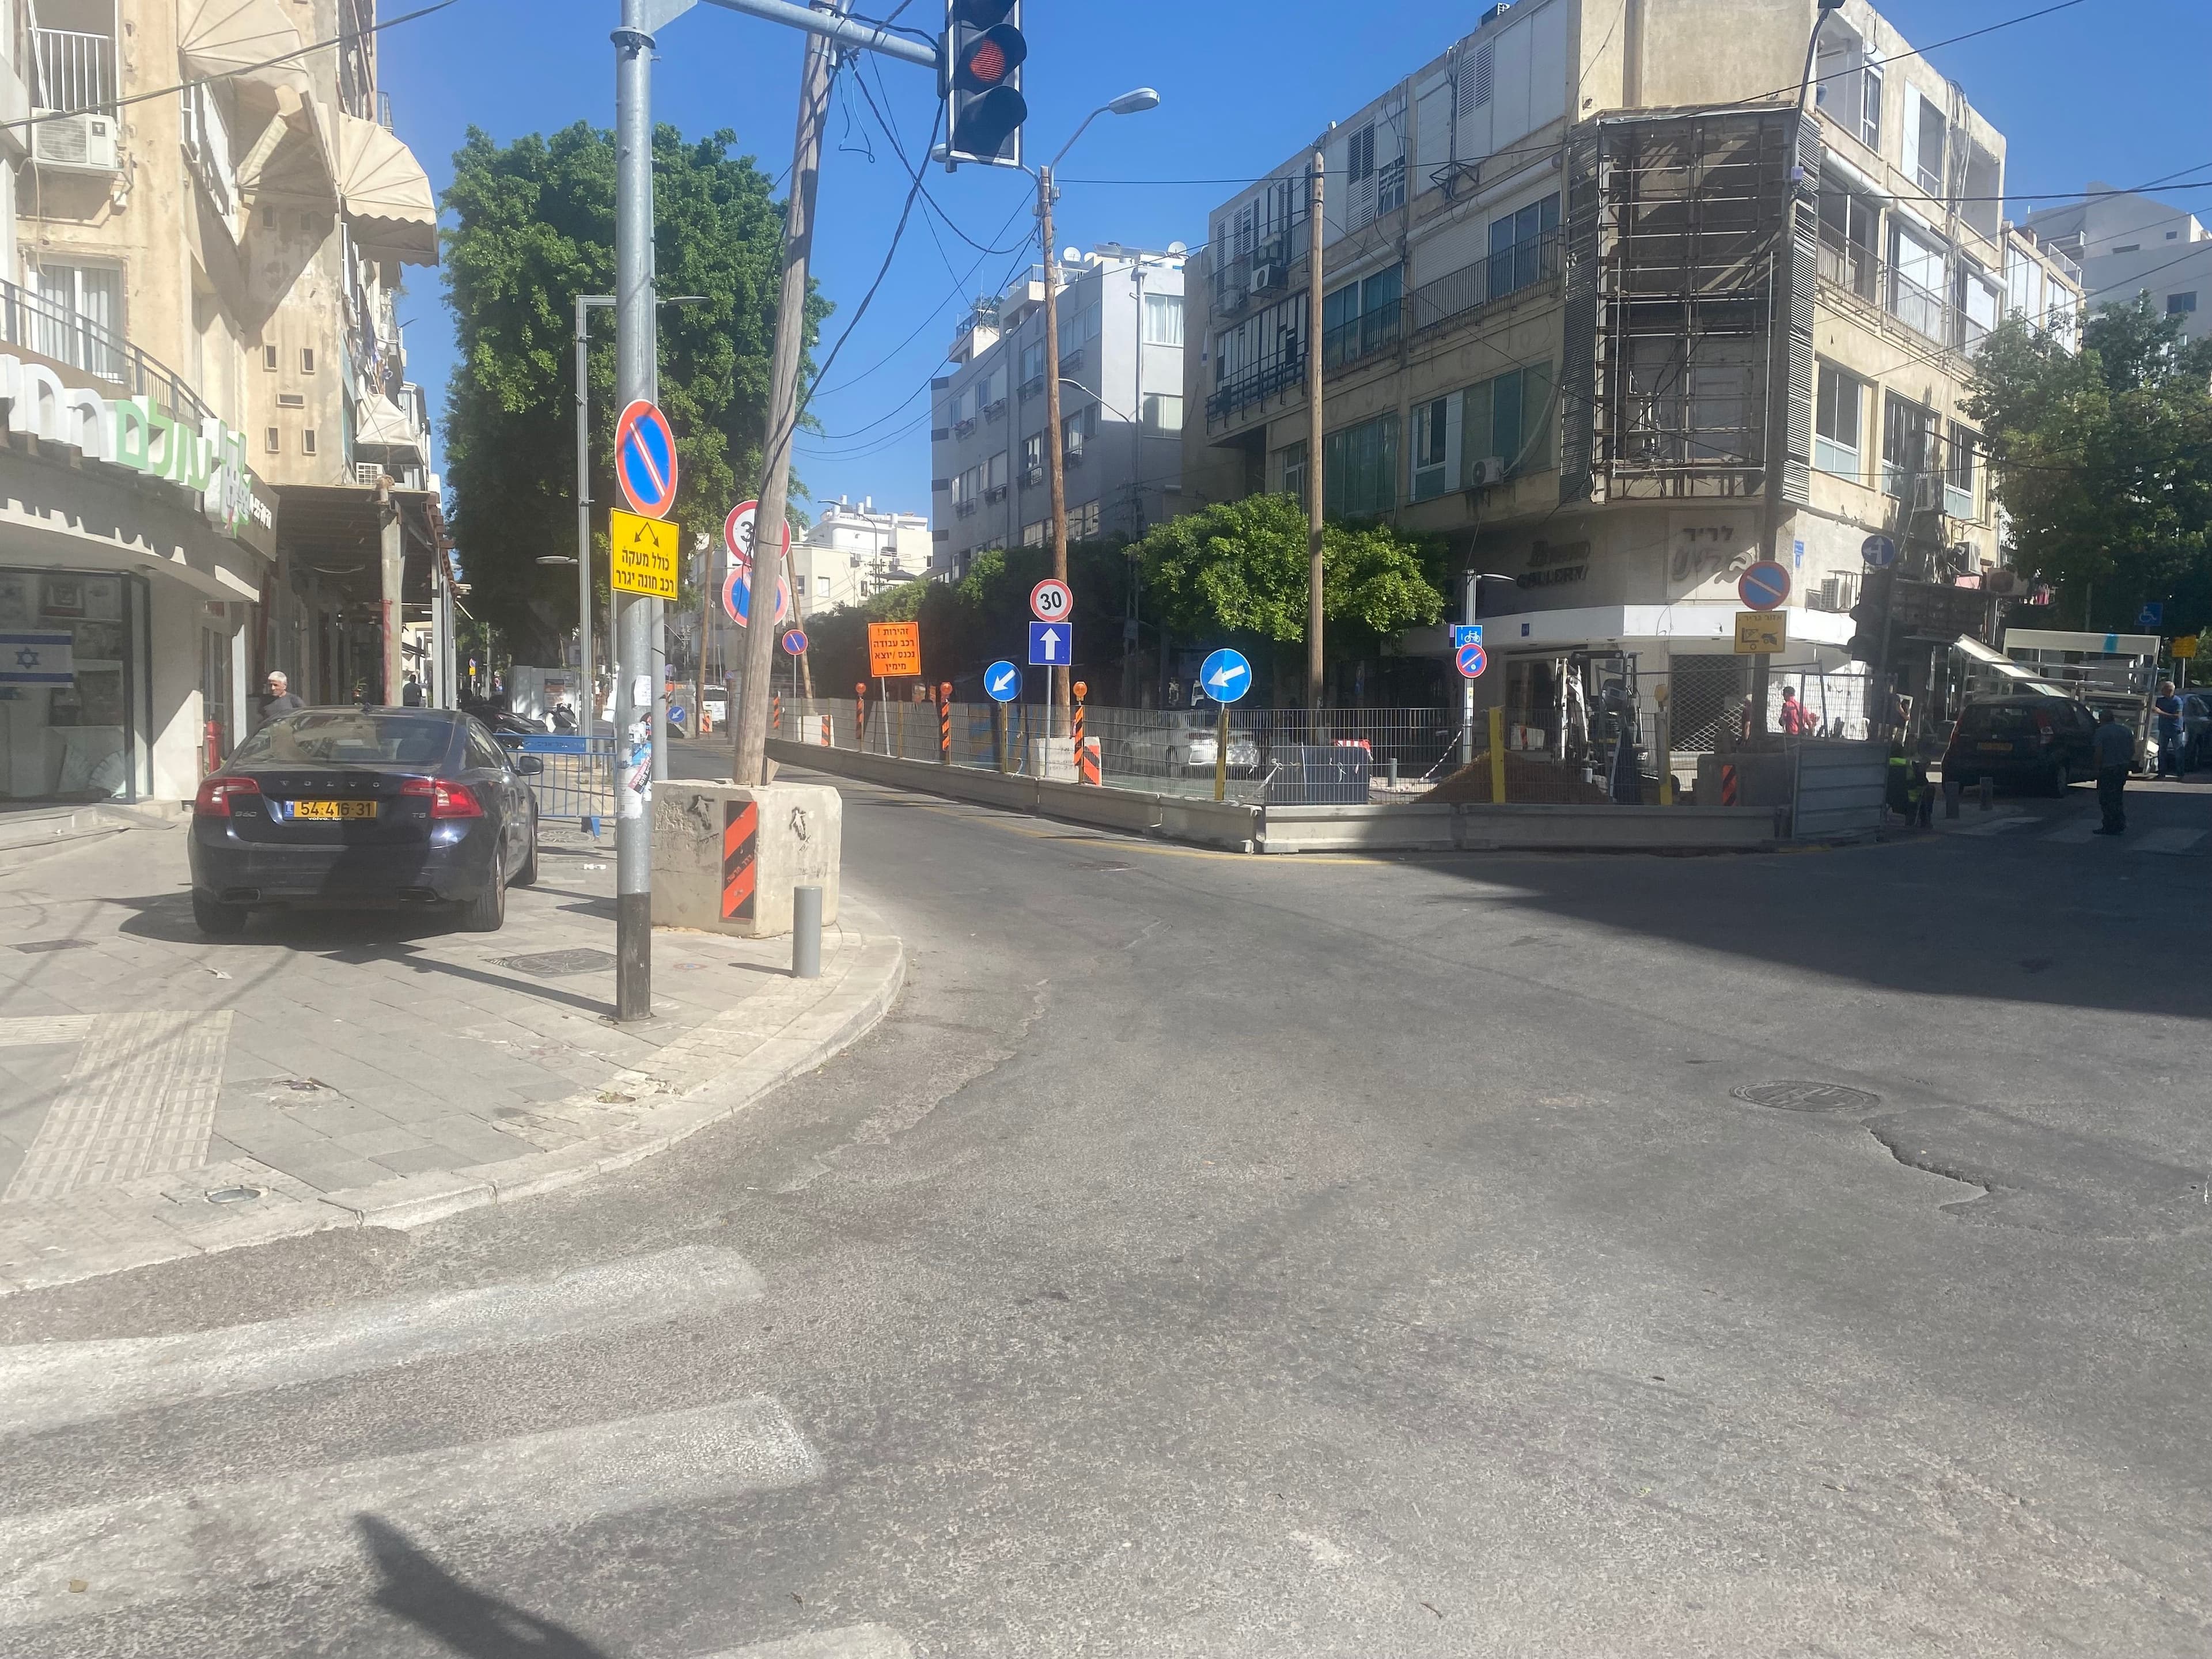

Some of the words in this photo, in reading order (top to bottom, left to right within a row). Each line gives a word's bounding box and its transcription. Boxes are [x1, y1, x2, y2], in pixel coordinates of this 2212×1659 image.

[116, 396, 212, 492] עולם
[622, 550, 649, 567] מעקה
[652, 552, 669, 571] כולל
[616, 570, 634, 585] יגרר
[638, 574, 657, 589] חונה
[660, 578, 674, 592] רכב
[1040, 591, 1062, 610] 30
[885, 663, 906, 672] מימין
